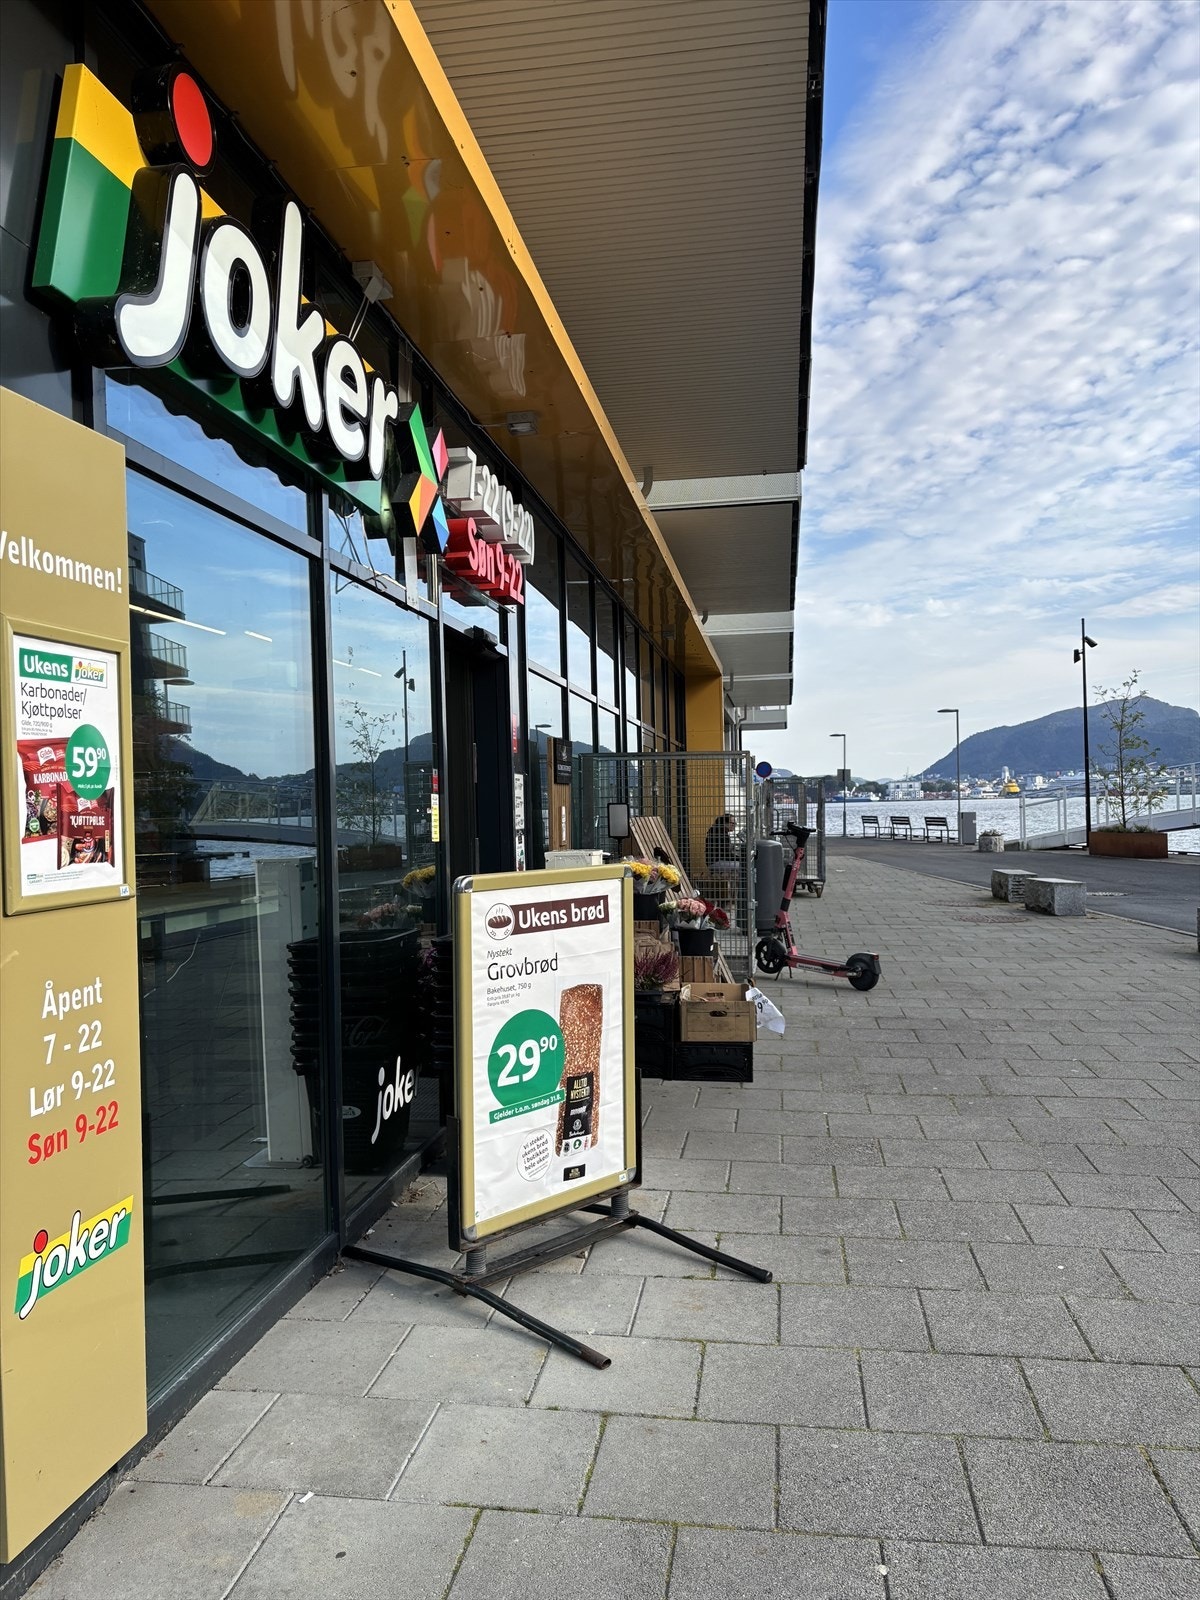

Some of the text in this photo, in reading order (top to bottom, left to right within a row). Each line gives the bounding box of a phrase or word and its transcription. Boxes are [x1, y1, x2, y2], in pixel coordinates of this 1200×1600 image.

[116, 72, 398, 480] joker
[467, 517, 524, 605] Søn 9-22
[23, 654, 104, 681] Ukens joker
[20, 682, 87, 706] Karbonader/
[21, 700, 82, 720] Kjøttpølser
[33, 771, 69, 784] KARBONAD
[518, 899, 605, 929] Ukens brød
[487, 947, 513, 960] Nystekt
[487, 952, 558, 981] Grovbrød
[42, 976, 103, 1021] Åpent
[487, 985, 517, 995] Bakehuset,
[517, 982, 527, 990] 750
[43, 1033, 57, 1065] 7
[78, 1020, 103, 1053] 22
[29, 1059, 115, 1118] Lør 9-22
[493, 1108, 514, 1120] Gjelder
[514, 1104, 531, 1114] t.o.m.
[531, 1097, 550, 1109] søndag
[28, 1101, 119, 1165] Søn 9-22
[19, 1207, 127, 1320] joker
